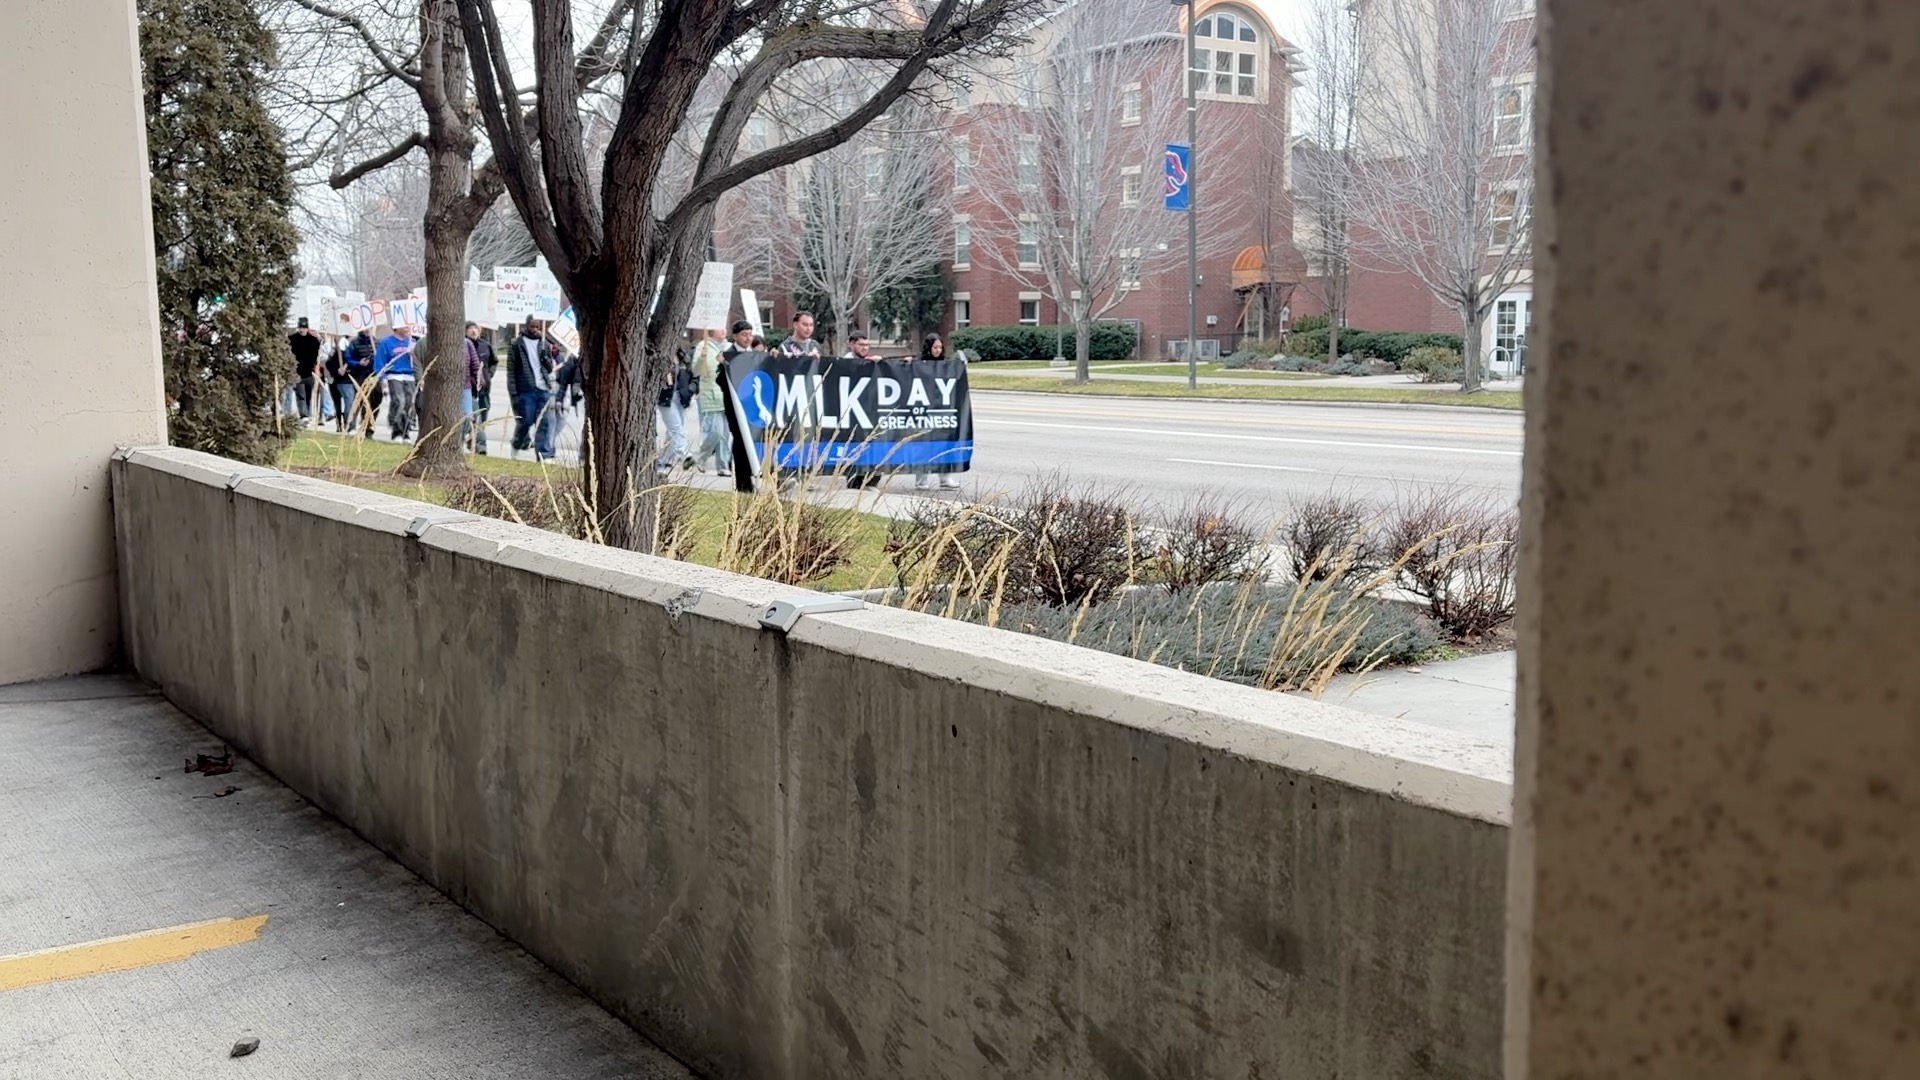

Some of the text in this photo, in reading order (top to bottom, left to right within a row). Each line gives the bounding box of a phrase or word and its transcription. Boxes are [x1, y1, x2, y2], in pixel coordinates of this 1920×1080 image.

[497, 281, 526, 292] LOVE
[776, 373, 957, 429] MLK DAY
[912, 407, 925, 415] OF
[878, 416, 958, 429] GREATNESS
